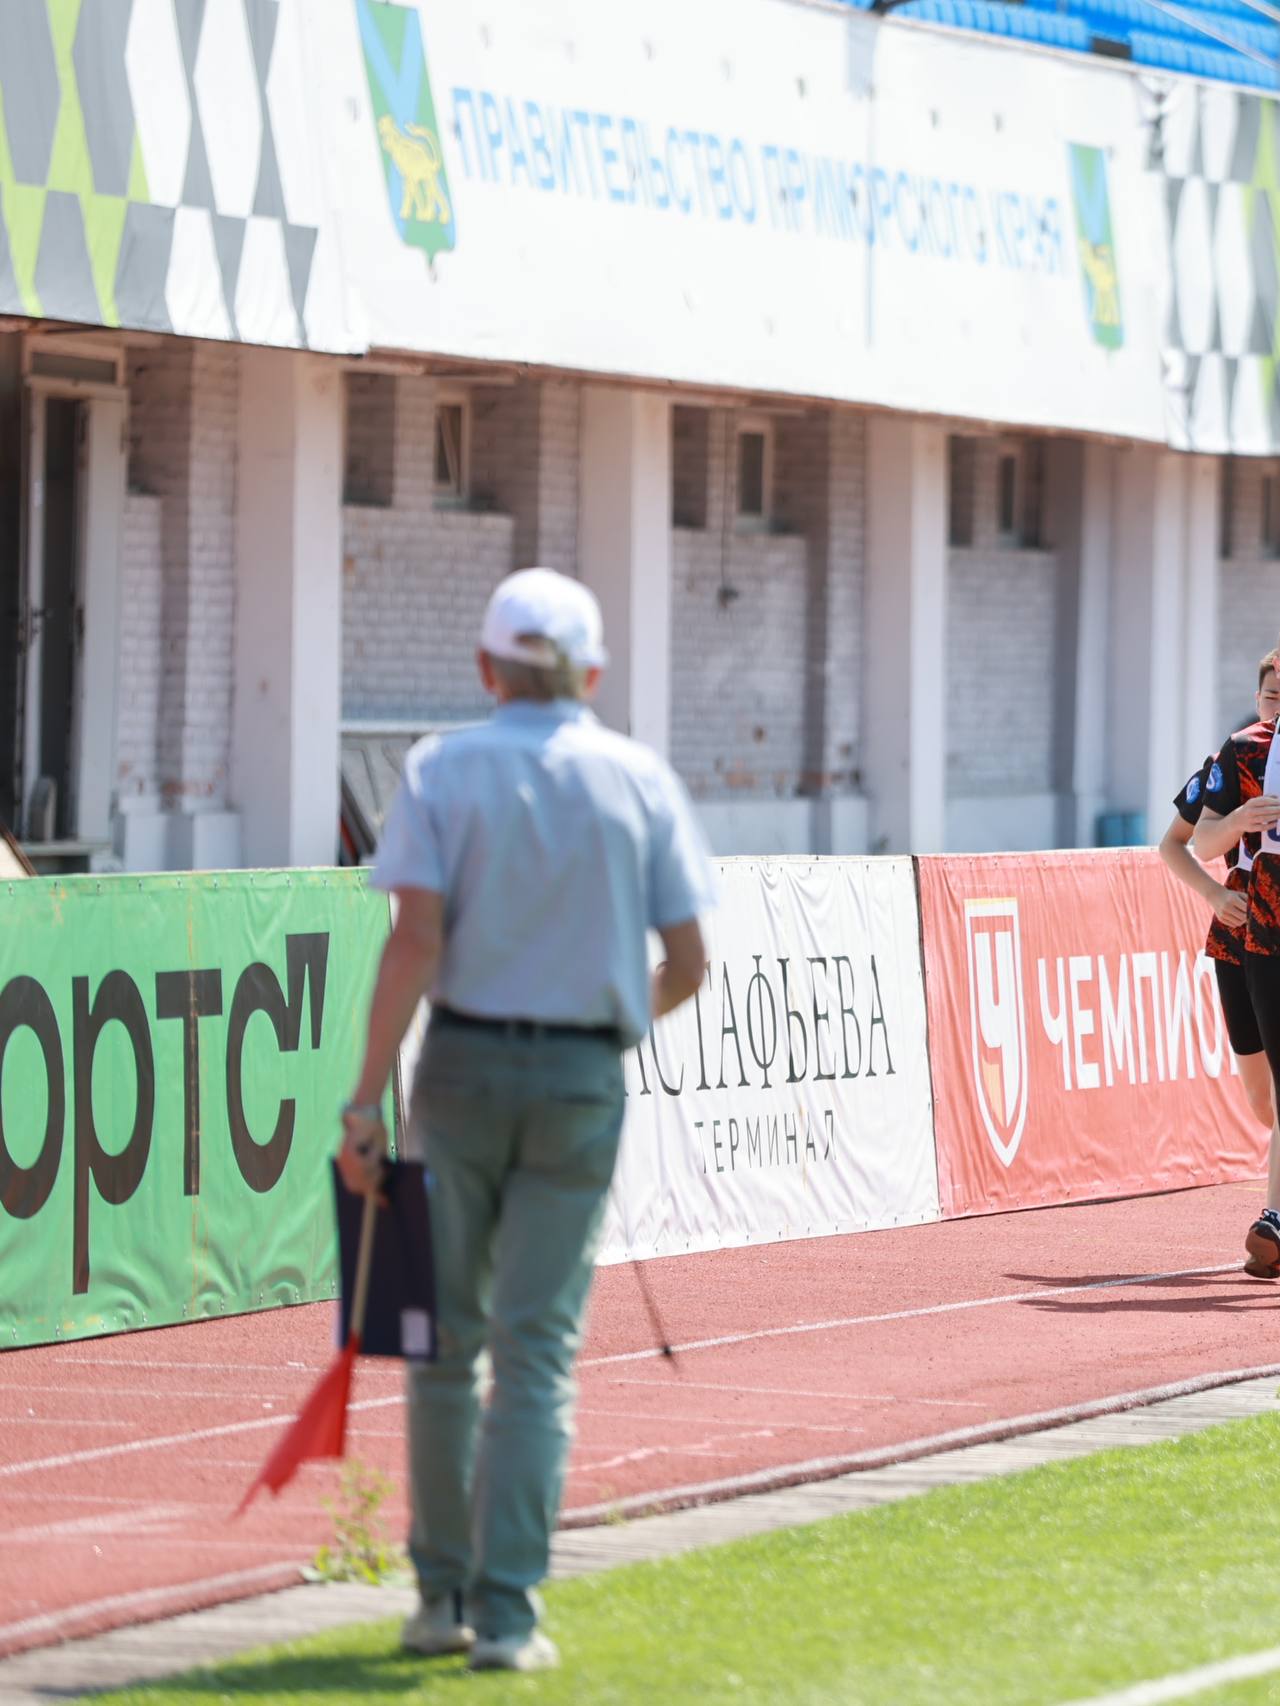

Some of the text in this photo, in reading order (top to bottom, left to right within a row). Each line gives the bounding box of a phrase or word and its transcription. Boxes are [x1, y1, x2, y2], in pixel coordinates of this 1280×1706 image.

[450, 86, 757, 225] ПРАВИТЕЛЬСТВО
[759, 143, 988, 266] ПРИМОРСКОГО
[1038, 948, 1239, 1091] ЧЕМПИО
[694, 1109, 836, 1174] ТЕРМИНАЛ
